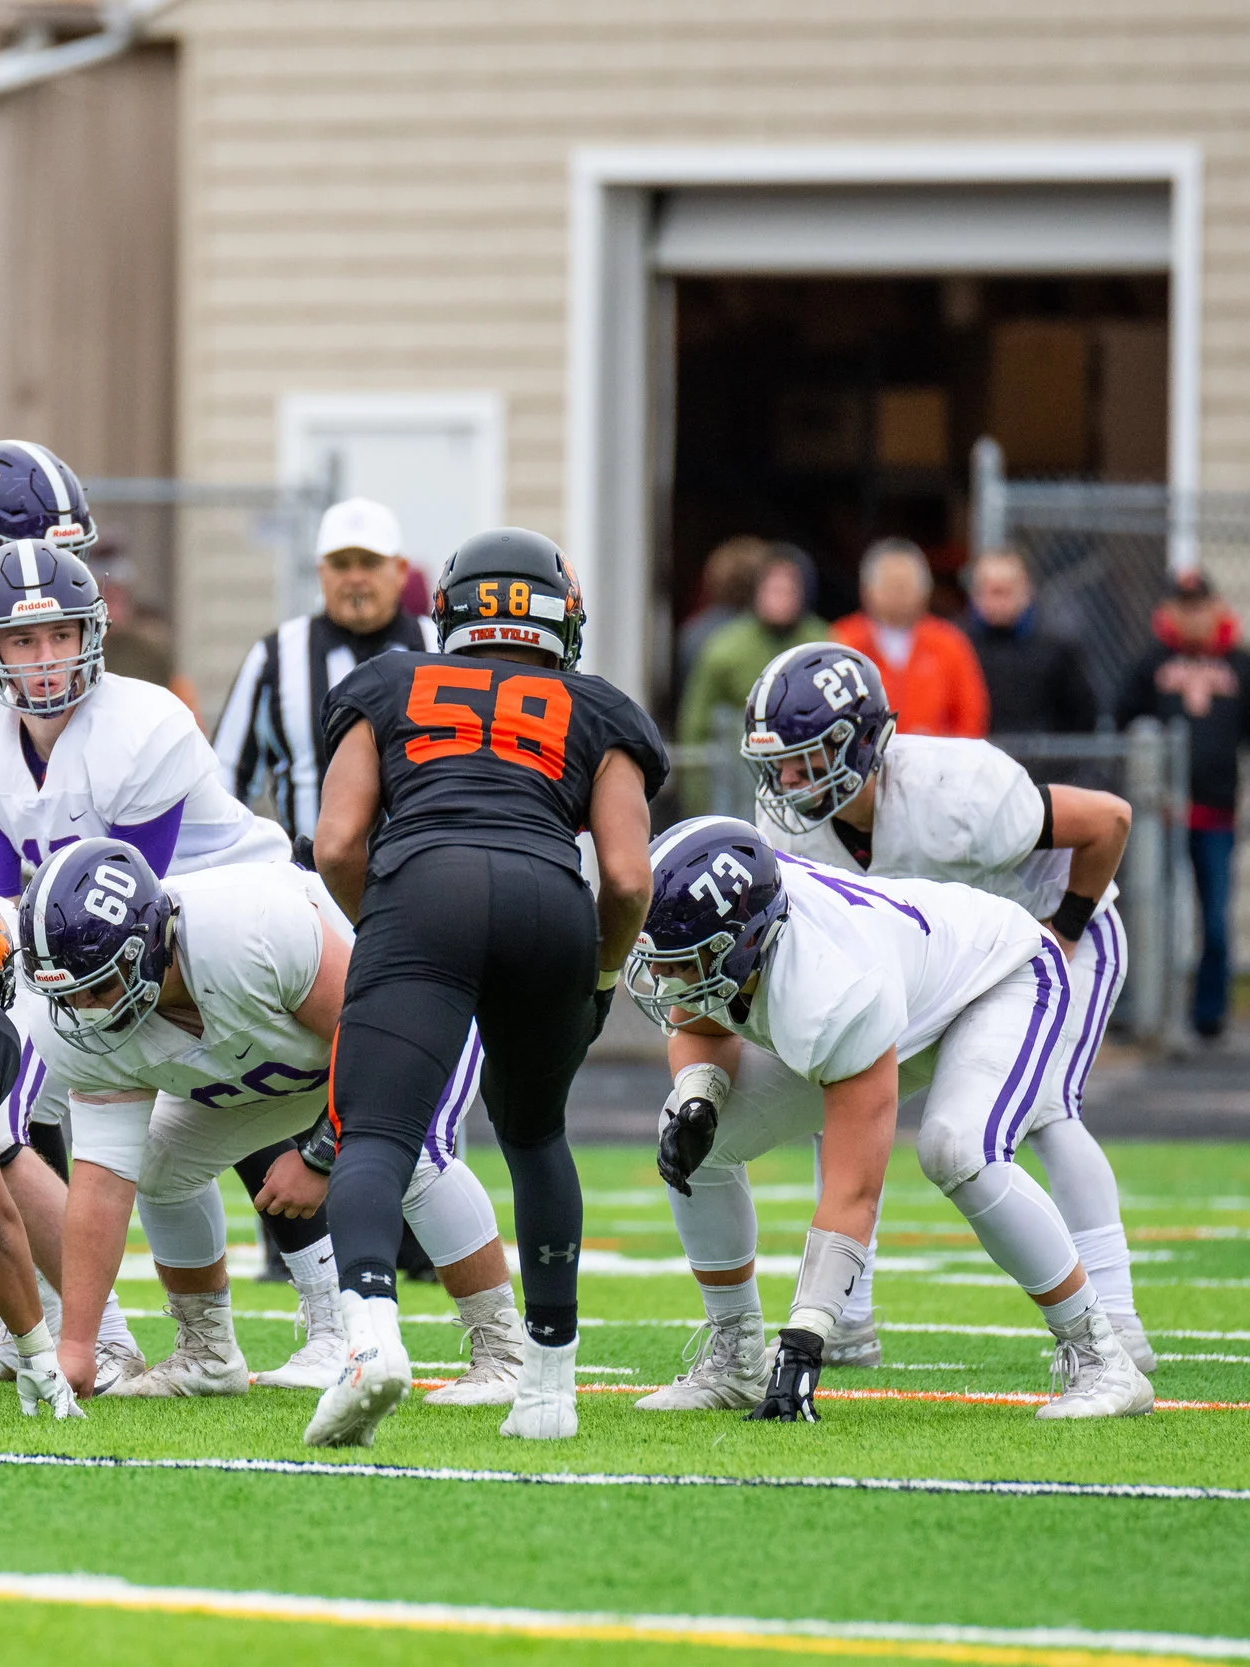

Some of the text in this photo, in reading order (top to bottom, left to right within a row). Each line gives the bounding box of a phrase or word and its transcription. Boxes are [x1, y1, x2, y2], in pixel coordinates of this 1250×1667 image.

[53, 528, 81, 537] Riddell
[17, 600, 54, 612] Riddell
[478, 582, 530, 617] 58
[469, 627, 541, 645] THE VILLE
[813, 658, 869, 712] 27
[405, 664, 573, 781] 58
[83, 864, 137, 926] 60
[688, 852, 753, 918] 73
[35, 973, 66, 982] Riddell
